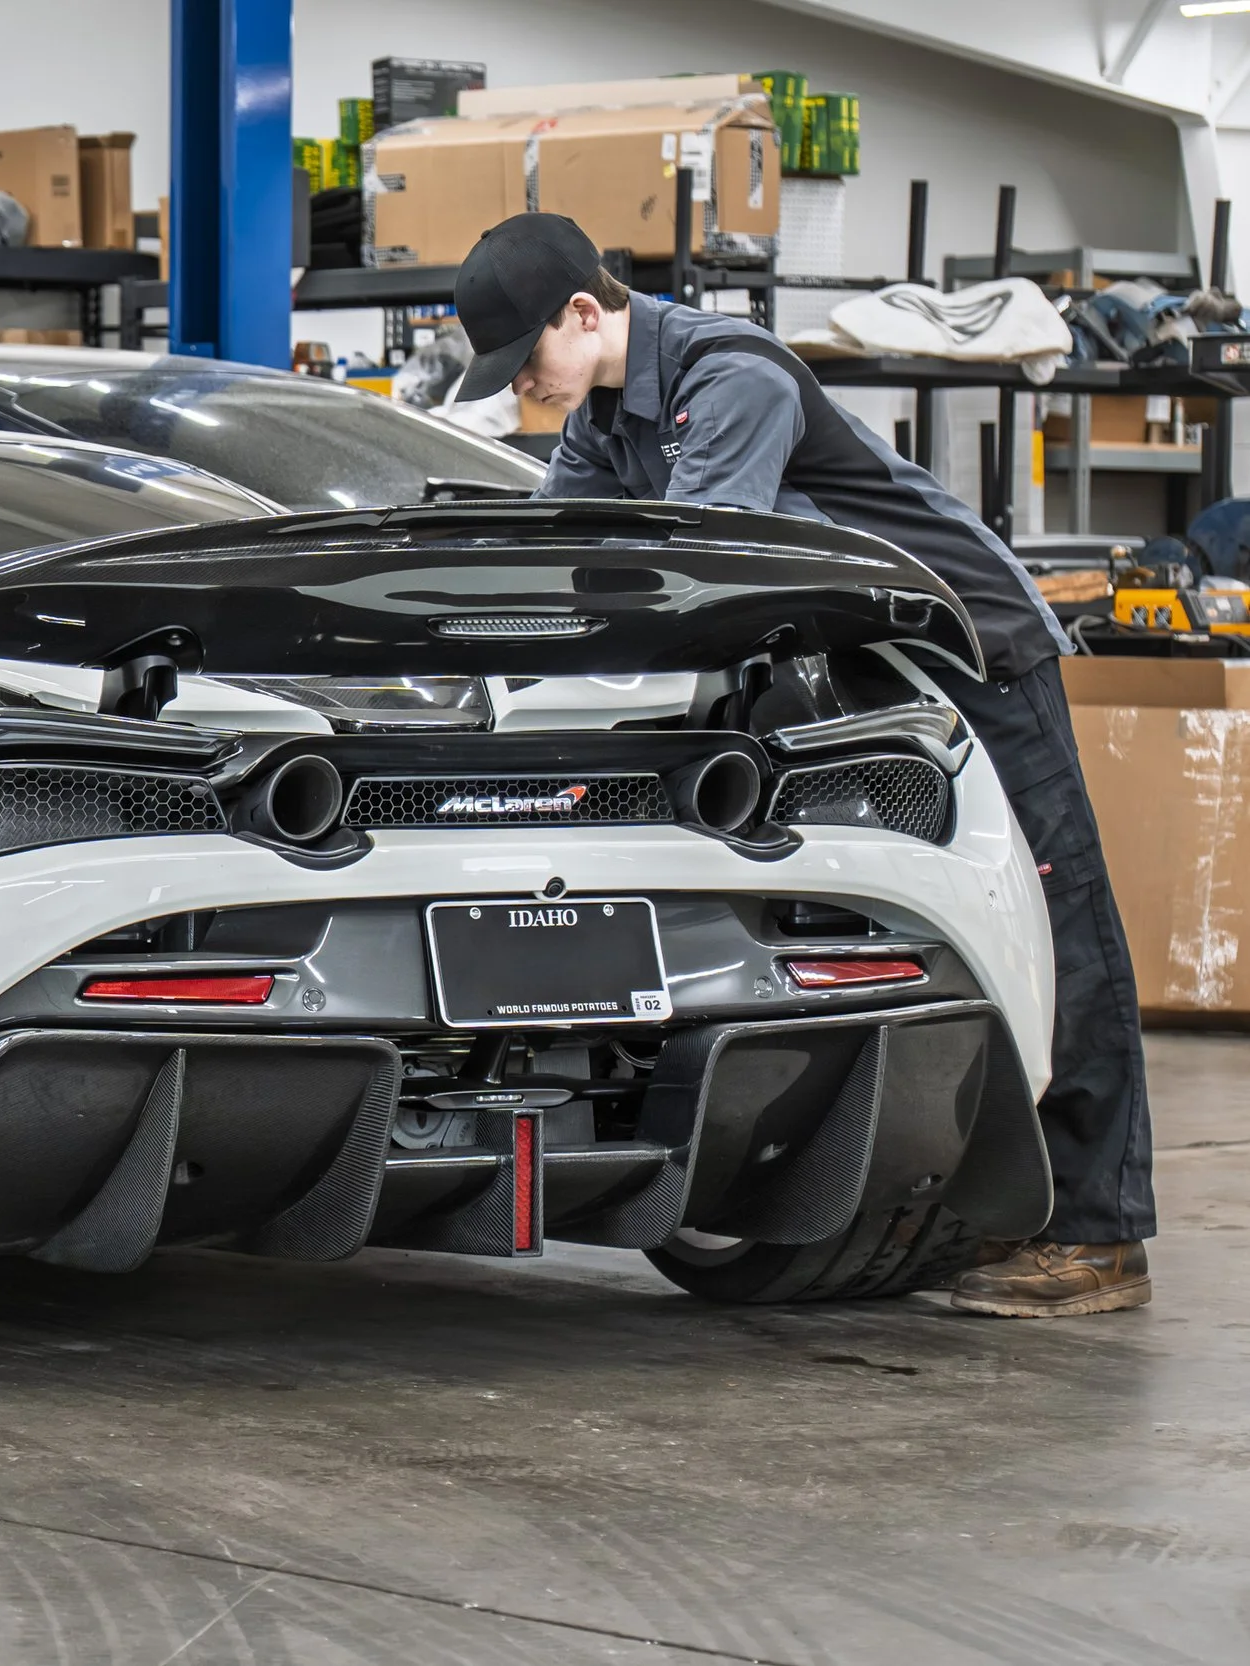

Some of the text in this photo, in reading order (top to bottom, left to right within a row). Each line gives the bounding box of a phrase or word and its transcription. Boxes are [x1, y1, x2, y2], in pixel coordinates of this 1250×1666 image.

[436, 796, 572, 813] McLaren
[508, 908, 578, 928] IDAHO
[496, 1001, 618, 1015] WORLD FAMOUS POTATOES
[644, 1000, 662, 1011] 02
